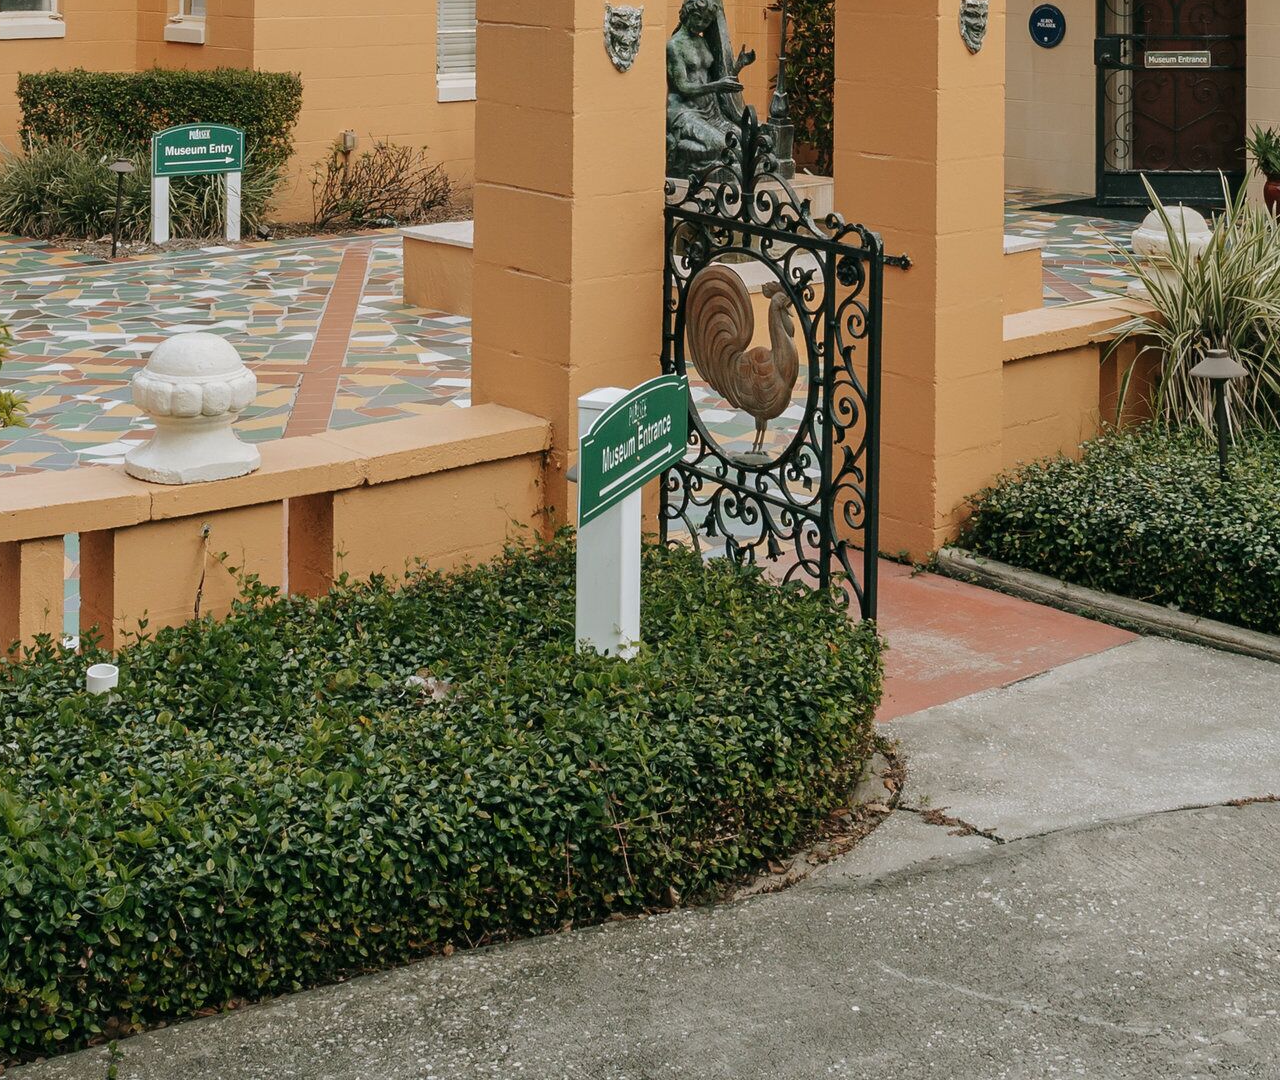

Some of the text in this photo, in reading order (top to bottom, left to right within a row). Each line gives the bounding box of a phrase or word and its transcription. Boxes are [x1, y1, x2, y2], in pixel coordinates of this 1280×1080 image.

[1148, 55, 1207, 63] Museum Entrance
[165, 143, 233, 156] Museum Entry
[602, 414, 672, 474] Museum Entrance
